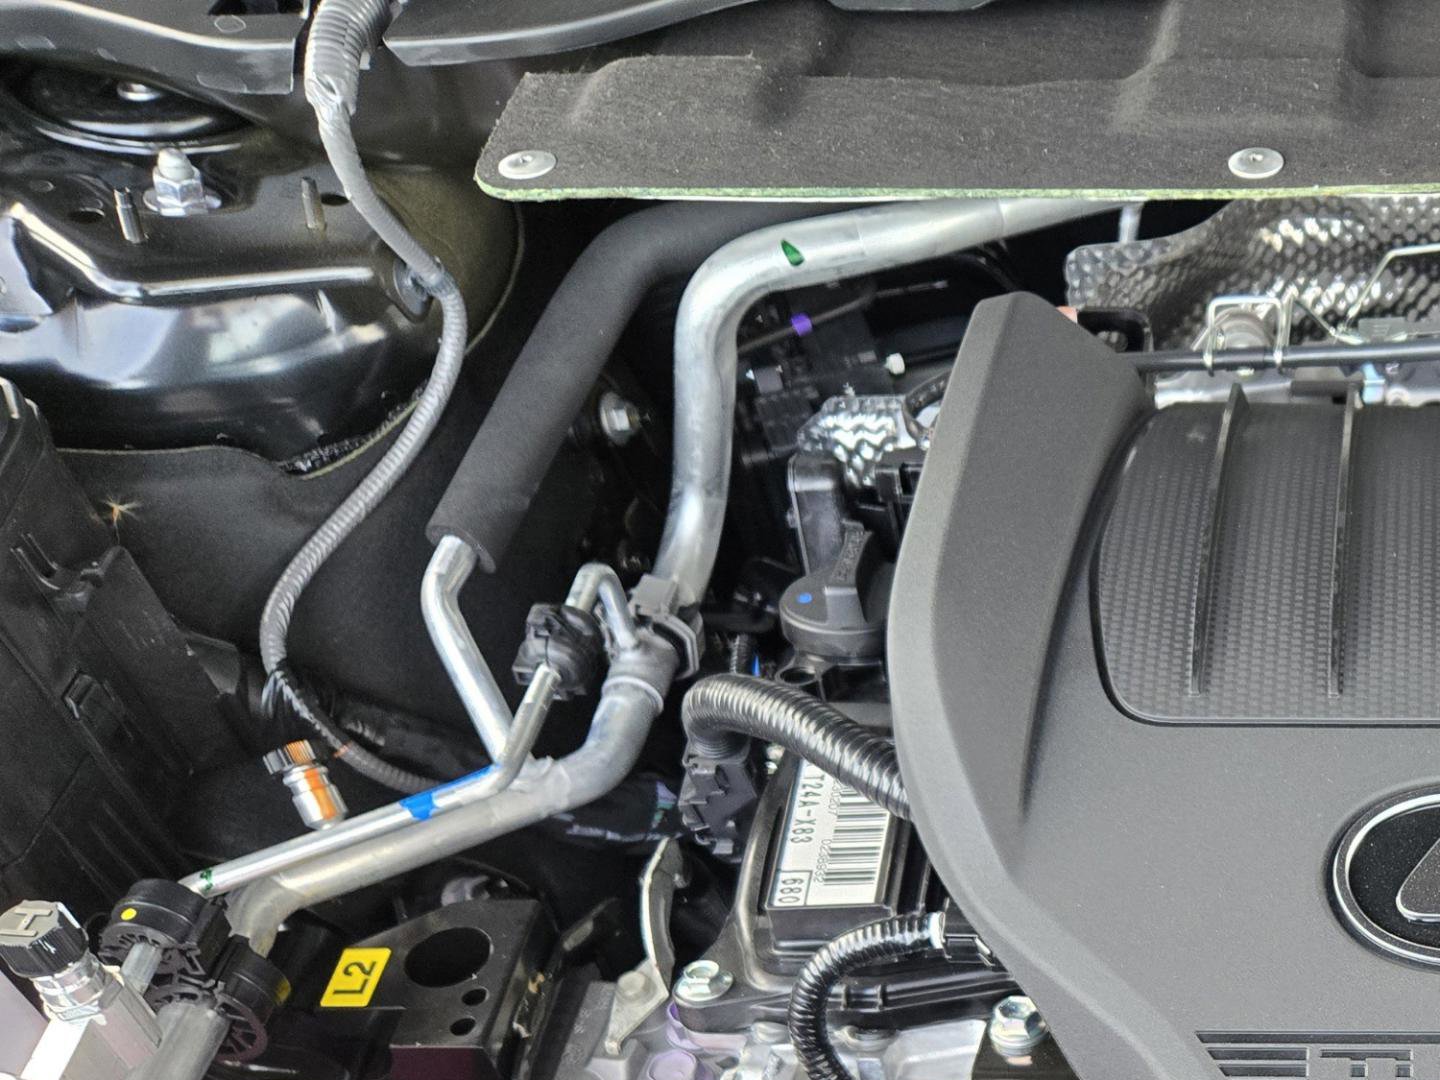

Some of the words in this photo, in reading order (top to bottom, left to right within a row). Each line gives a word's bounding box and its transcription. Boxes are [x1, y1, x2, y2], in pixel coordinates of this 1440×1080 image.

[790, 774, 825, 843] T24A-X83
[778, 878, 804, 904] 680
[333, 961, 377, 995] L2
